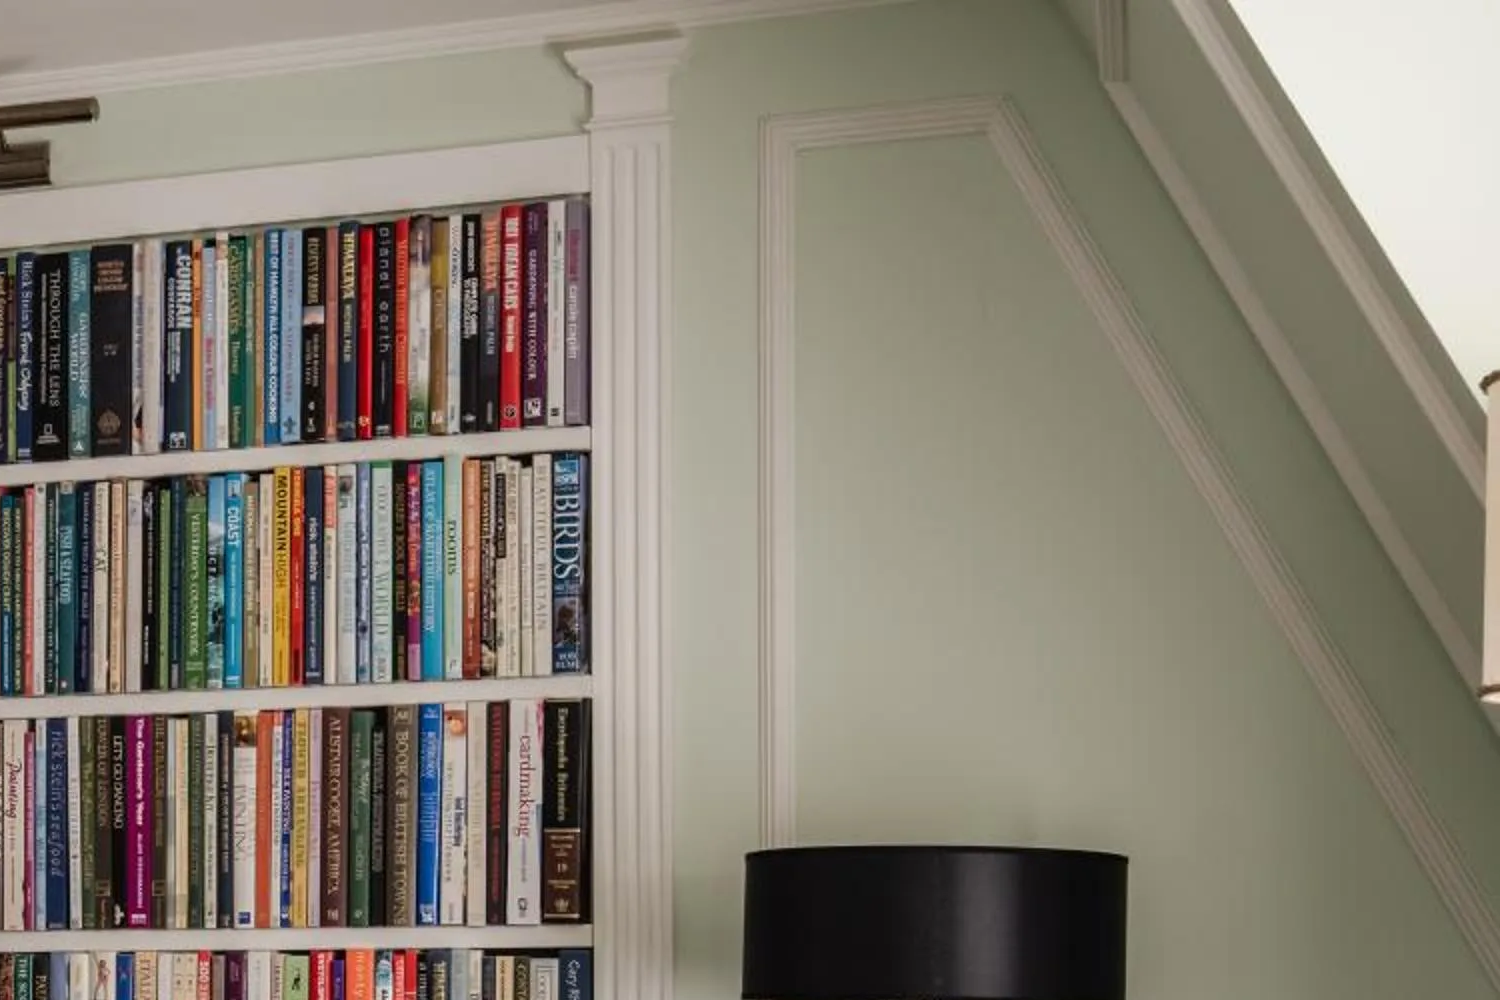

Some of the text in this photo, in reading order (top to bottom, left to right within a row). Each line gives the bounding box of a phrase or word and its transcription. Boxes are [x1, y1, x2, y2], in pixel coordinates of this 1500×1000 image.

[176, 256, 191, 329] CONRAN
[378, 227, 391, 353] planet earth
[505, 281, 518, 309] CARS
[50, 271, 60, 407] THROUGH THE LENS
[228, 506, 238, 547] COAST
[277, 475, 286, 550] MOUNTAIN
[447, 520, 457, 576] rooms
[553, 495, 580, 579] BIRDS
[276, 553, 286, 588] HIGH
[136, 718, 145, 738] The
[136, 802, 145, 826] Year
[515, 735, 536, 837] cardmaking
[395, 731, 409, 925] BOOK OF BRITISH TOWNS
